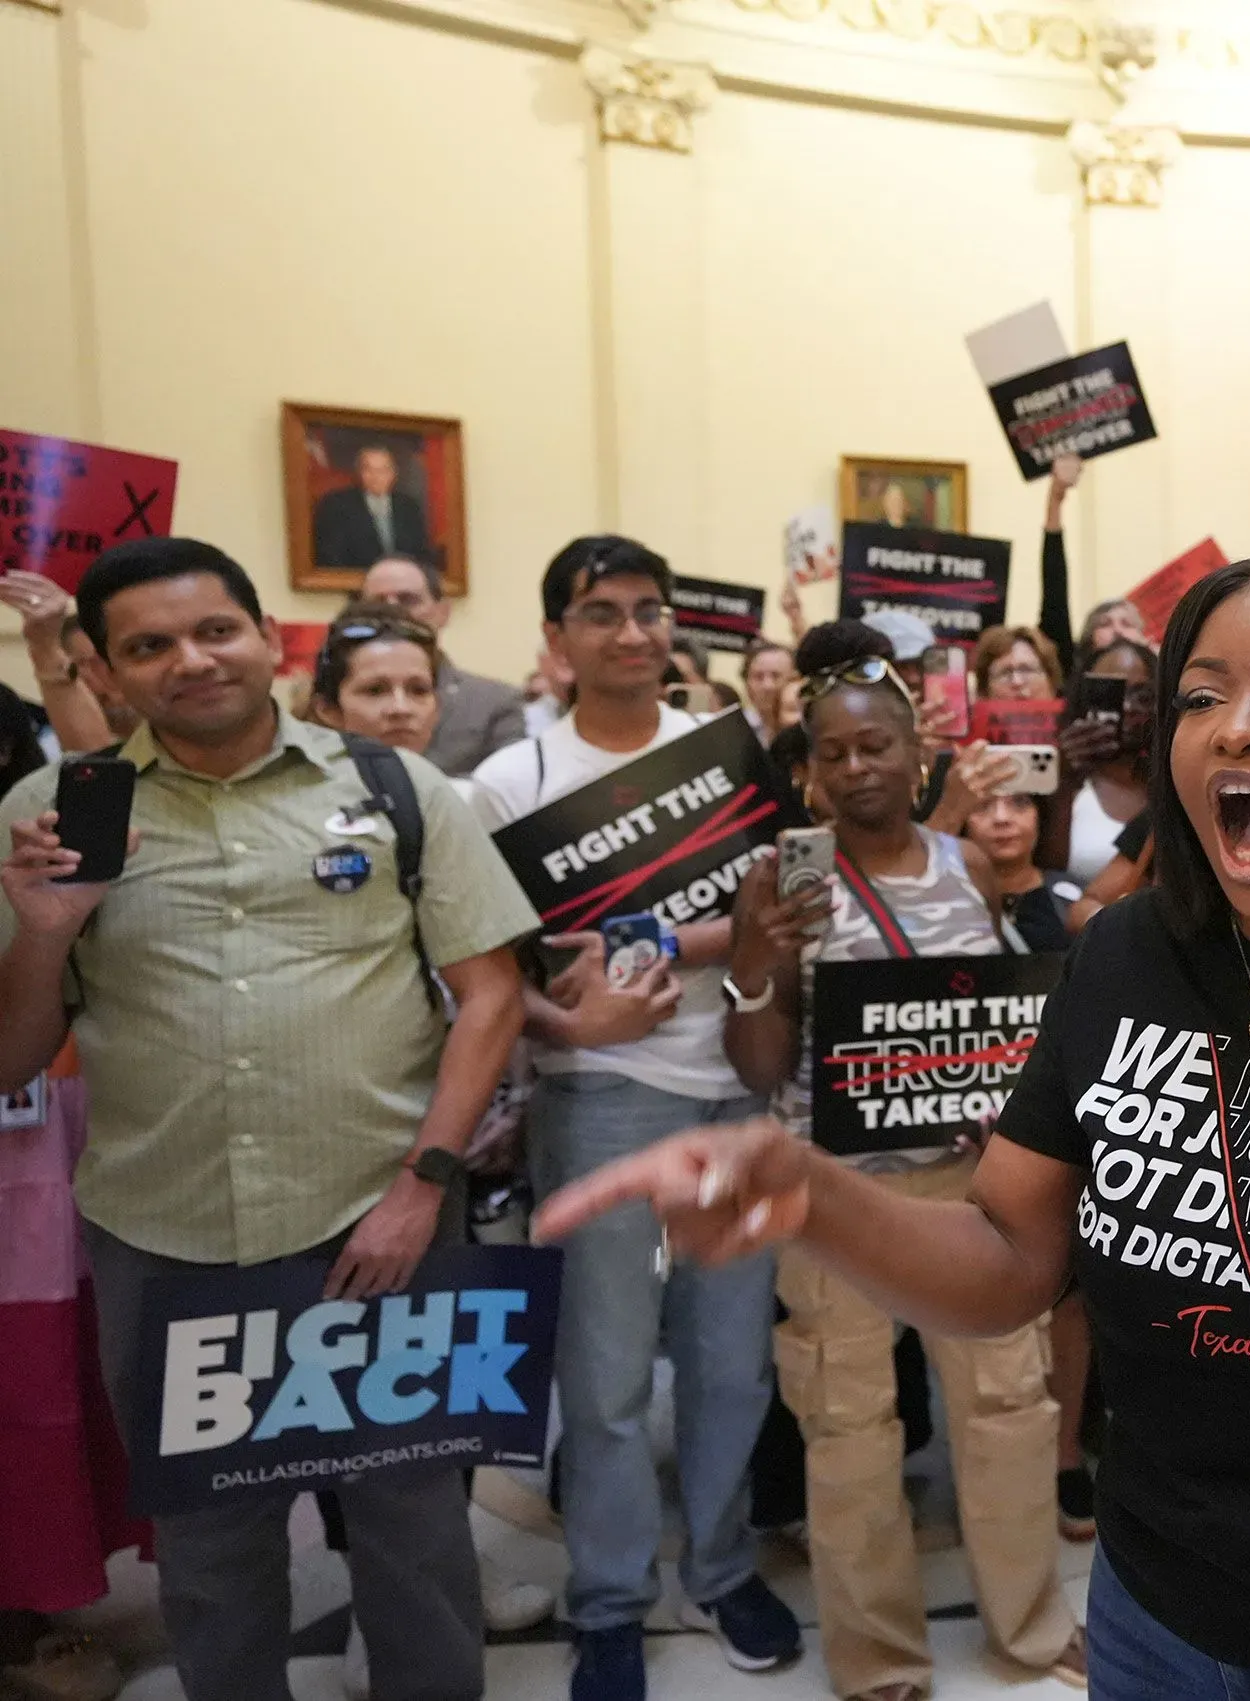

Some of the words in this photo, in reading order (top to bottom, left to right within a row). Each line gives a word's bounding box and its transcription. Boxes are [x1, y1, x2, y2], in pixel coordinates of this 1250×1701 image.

[939, 554, 986, 580] THE
[541, 802, 658, 884] FIGHT
[655, 765, 735, 820] THE
[862, 997, 978, 1034] FIGHT
[832, 1026, 1040, 1098] TRUM
[1100, 1016, 1231, 1103] WE
[857, 1088, 1014, 1130] TAKEOV
[1074, 1082, 1186, 1149] FOR
[163, 1288, 530, 1381] FIGHT
[158, 1342, 530, 1457] BACK
[211, 1436, 484, 1491] DALLASDEMOCRATS.ORG
